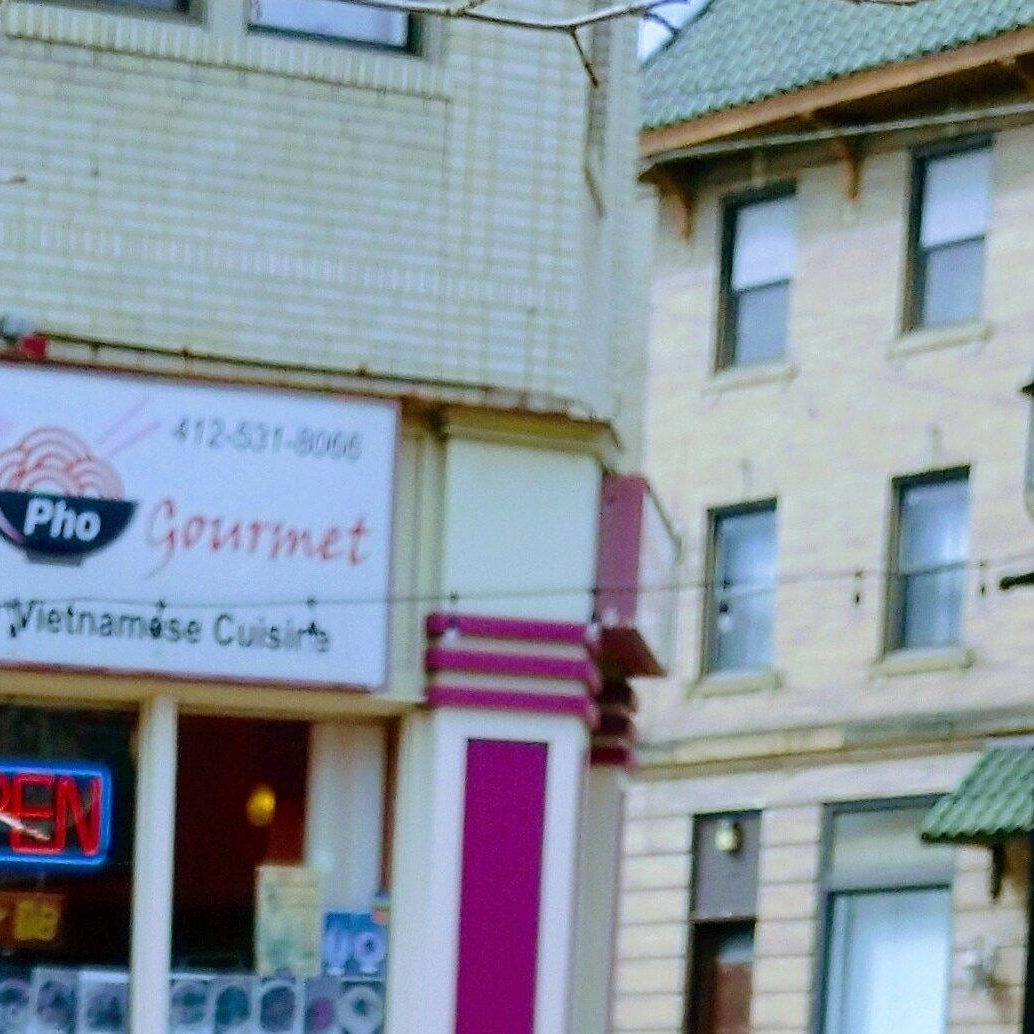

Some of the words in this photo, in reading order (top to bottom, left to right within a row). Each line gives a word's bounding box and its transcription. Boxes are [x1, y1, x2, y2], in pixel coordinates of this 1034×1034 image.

[23, 497, 102, 542] Pho
[144, 498, 371, 581] Gourmet
[8, 598, 202, 645] Vietnamese
